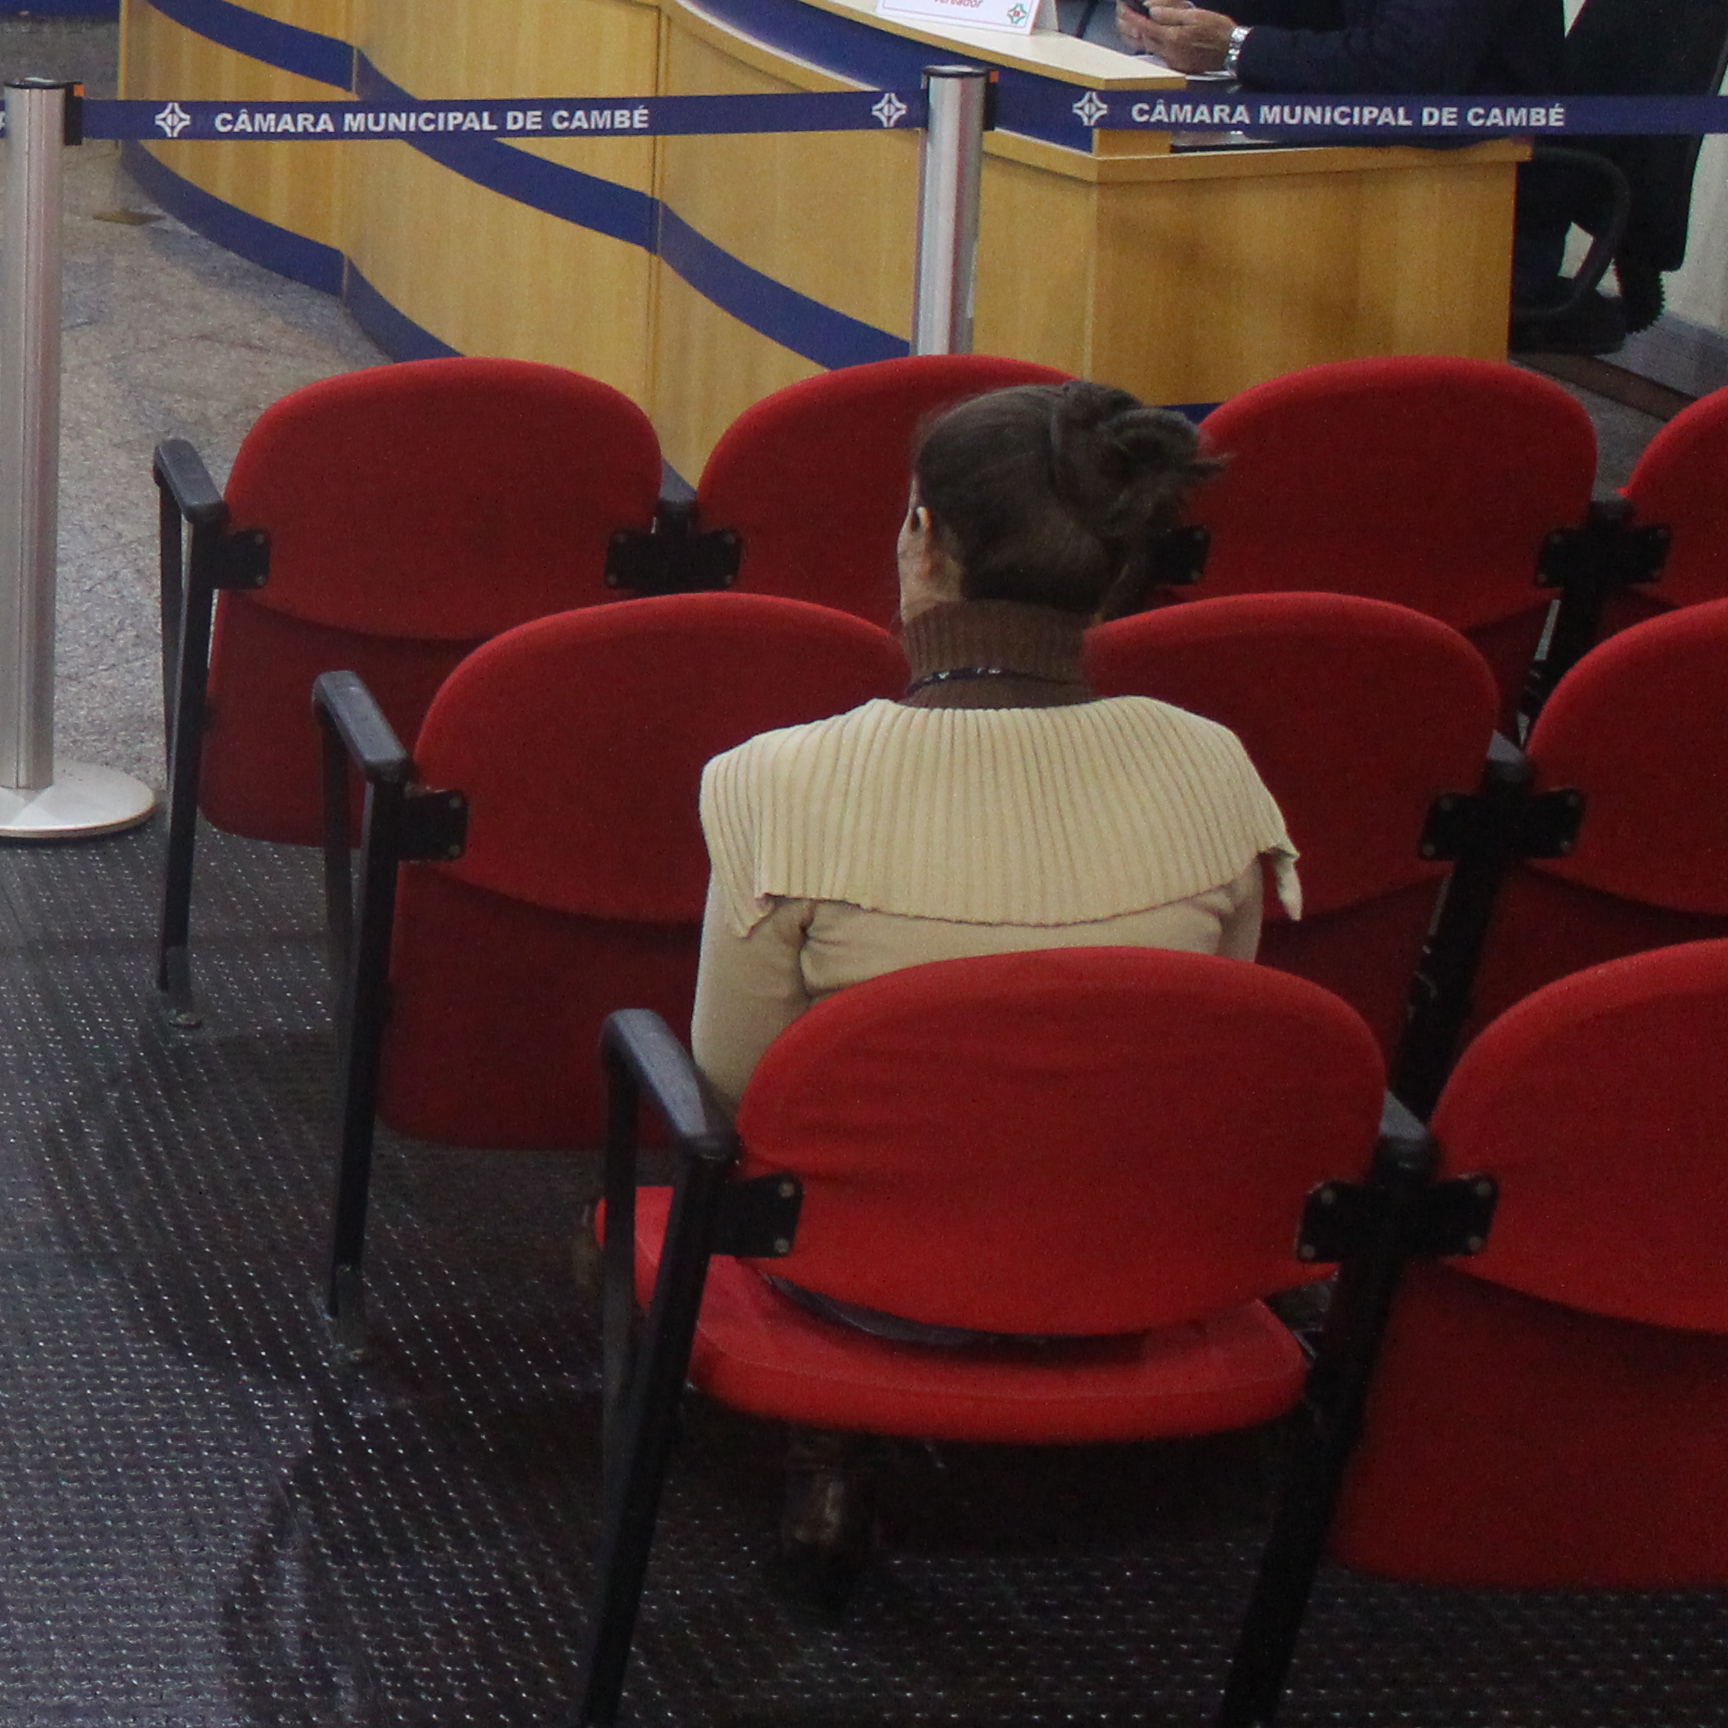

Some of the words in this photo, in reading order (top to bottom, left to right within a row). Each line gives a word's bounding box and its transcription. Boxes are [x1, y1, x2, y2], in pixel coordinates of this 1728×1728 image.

[213, 107, 336, 134] CÂMARA
[343, 111, 499, 134] MUNICIPAL
[505, 110, 546, 133] DE
[552, 102, 650, 132] CAMBÉ
[1130, 99, 1251, 125] CÂMARA
[1257, 104, 1416, 127] MUNICIPAL
[1422, 105, 1462, 128] DE
[1466, 98, 1566, 128] CAMBÉ
